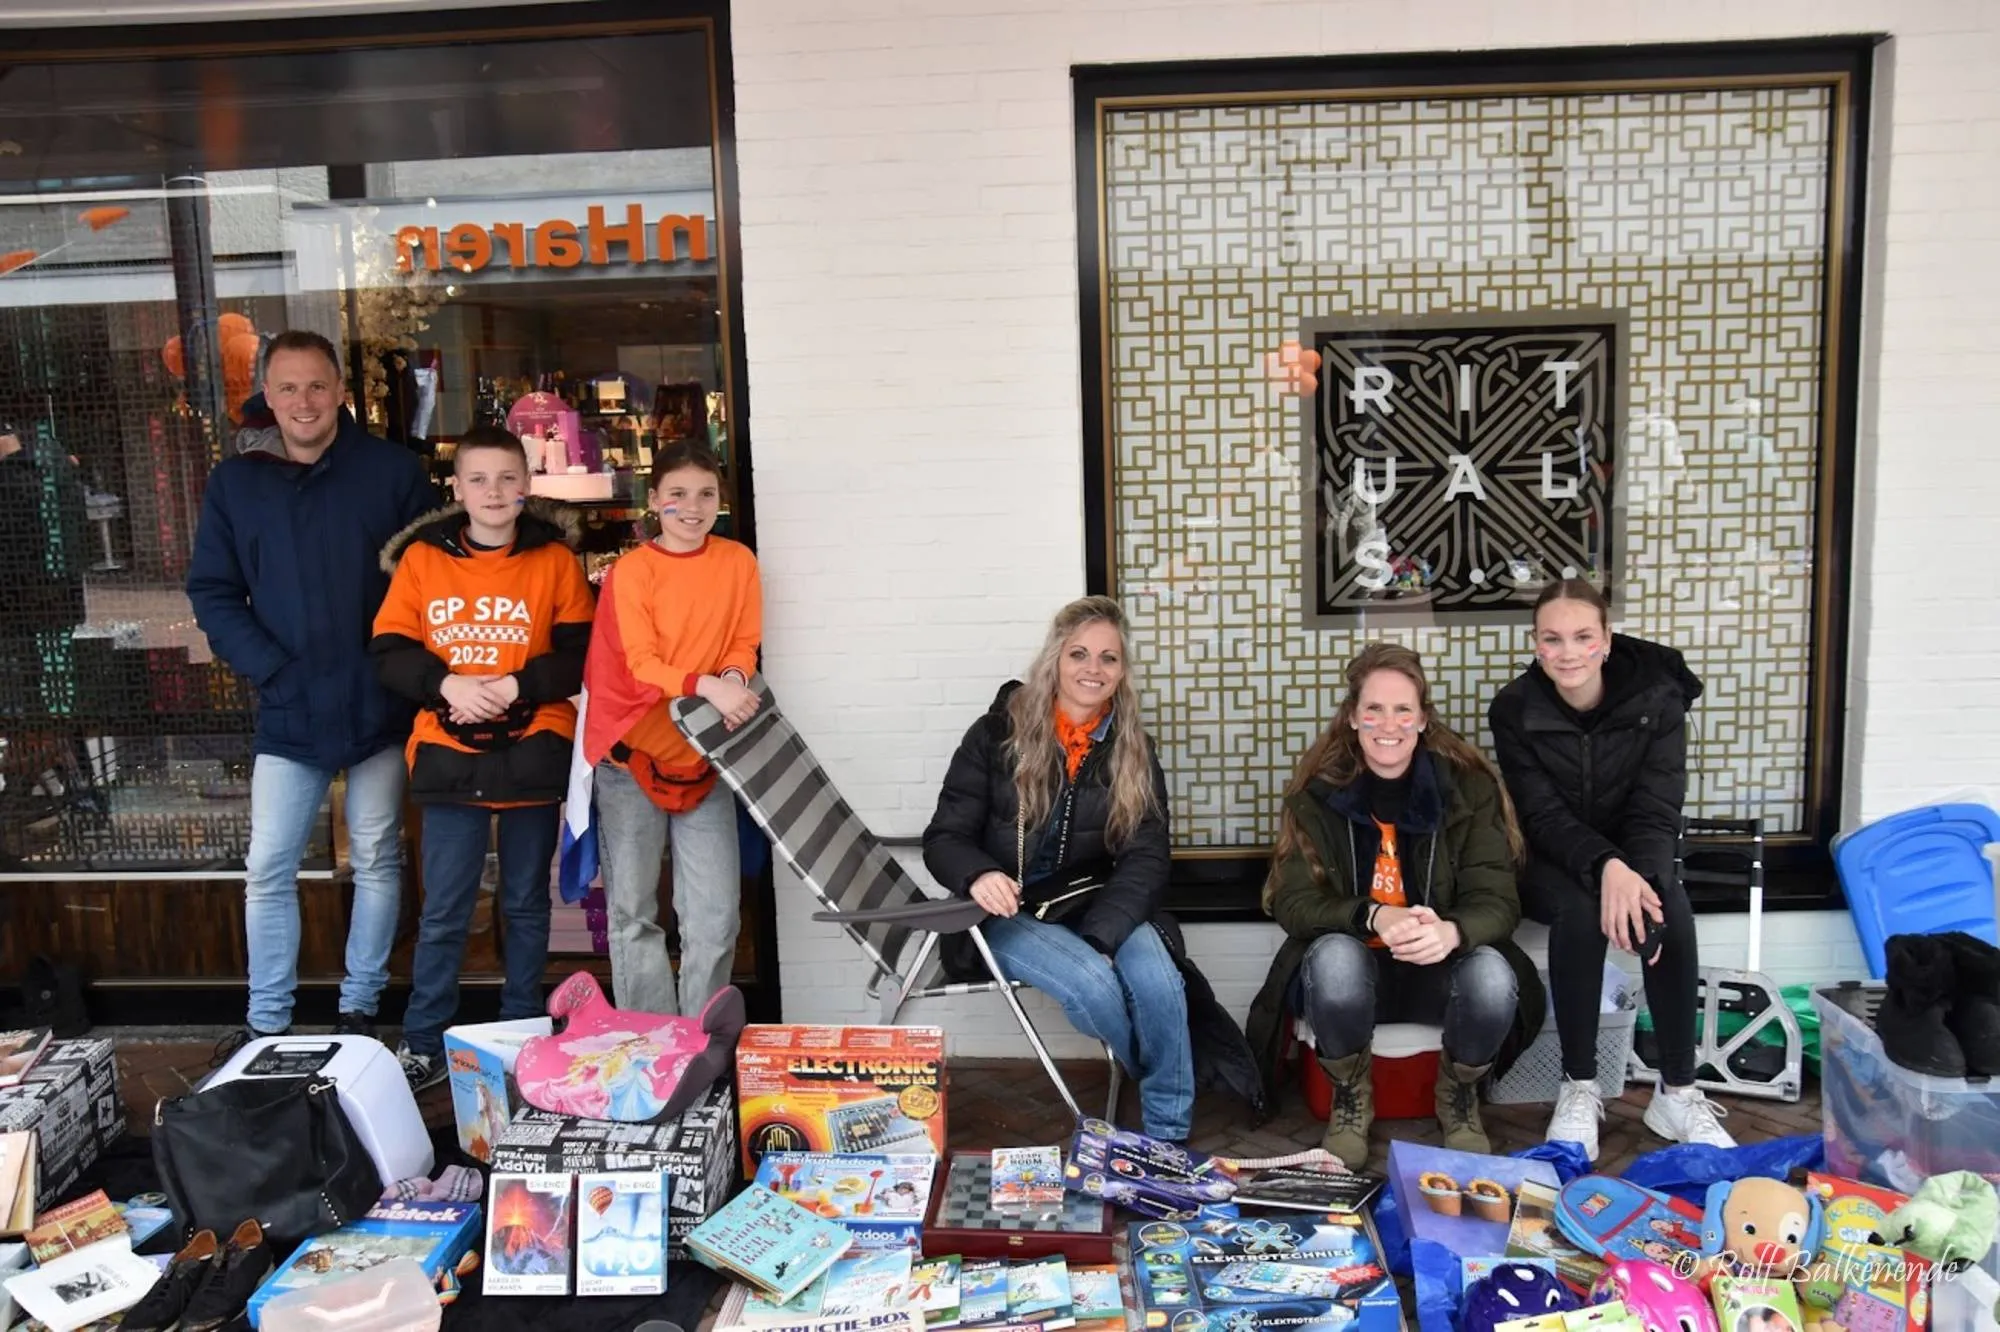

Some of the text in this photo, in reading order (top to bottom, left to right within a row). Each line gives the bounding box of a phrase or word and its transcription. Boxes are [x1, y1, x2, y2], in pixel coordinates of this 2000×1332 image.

[427, 596, 531, 625] GP SPA
[449, 645, 498, 666] 2022
[787, 1056, 938, 1075] ELECTRONIC
[874, 1074, 937, 1086] BASIS LAB
[494, 1159, 547, 1175] HAPPY
[767, 1156, 884, 1166] Scheikundedoos
[1268, 1168, 1372, 1184] DINOSAURIERS
[364, 1202, 461, 1221] inisteck
[706, 1226, 734, 1245] Het
[1192, 1248, 1356, 1264] ELEKTROTECHNIEK
